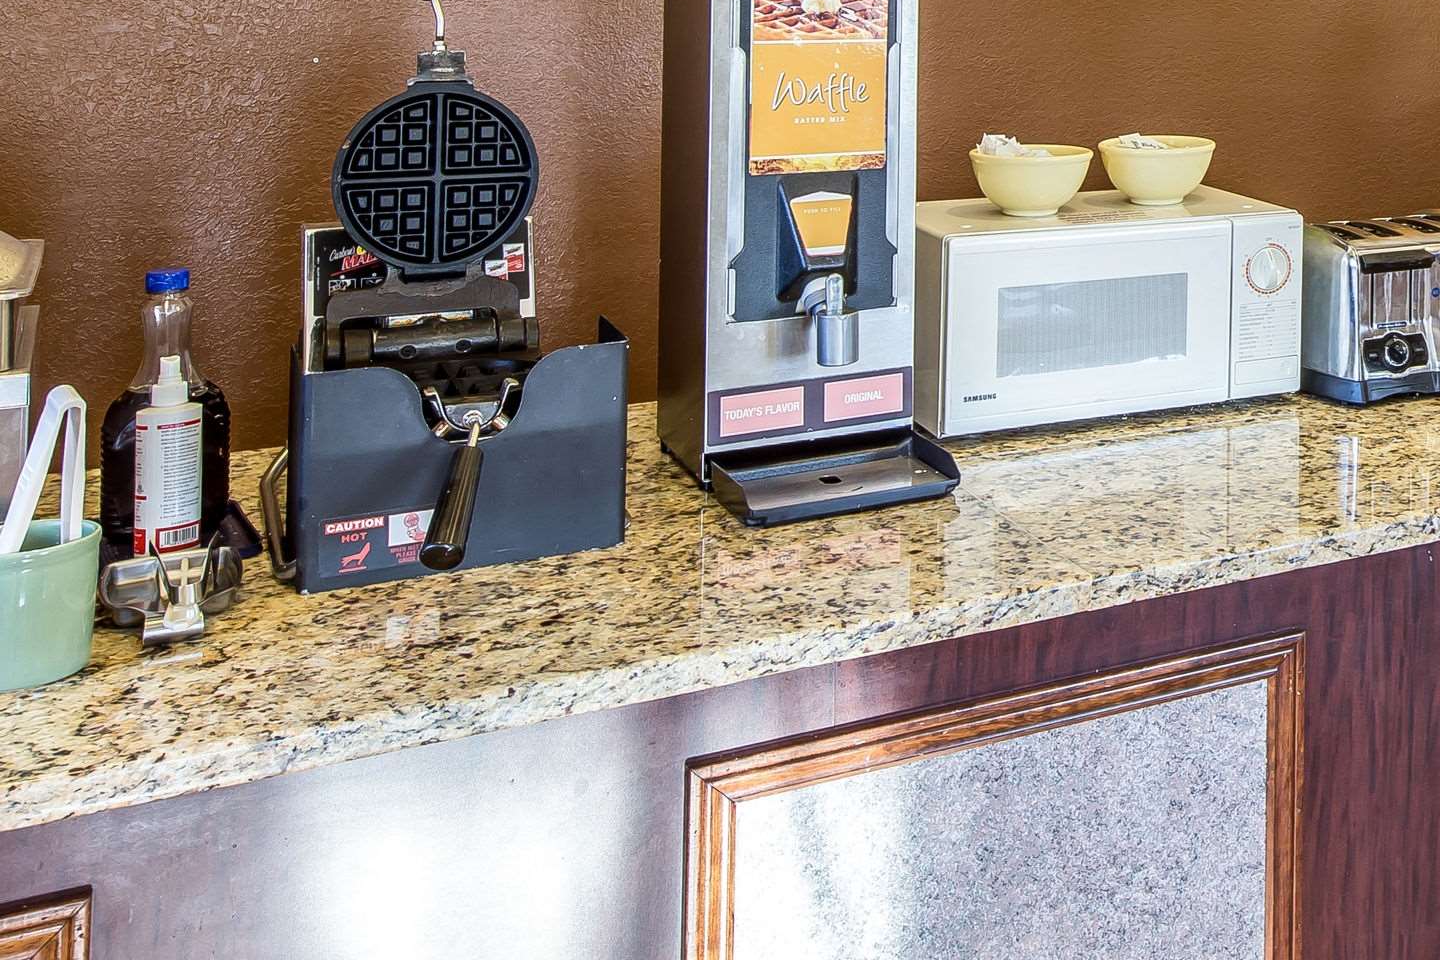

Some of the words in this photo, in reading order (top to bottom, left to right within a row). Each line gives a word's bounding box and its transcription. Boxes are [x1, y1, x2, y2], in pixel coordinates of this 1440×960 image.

[771, 71, 870, 113] Waffle
[844, 389, 884, 405] ORIGINAL
[963, 392, 997, 403] SAMSUNG
[724, 406, 763, 422] TODAY'S
[764, 401, 801, 416] FLAVOR
[325, 516, 385, 534] CAUTION
[341, 531, 368, 543] HOT
